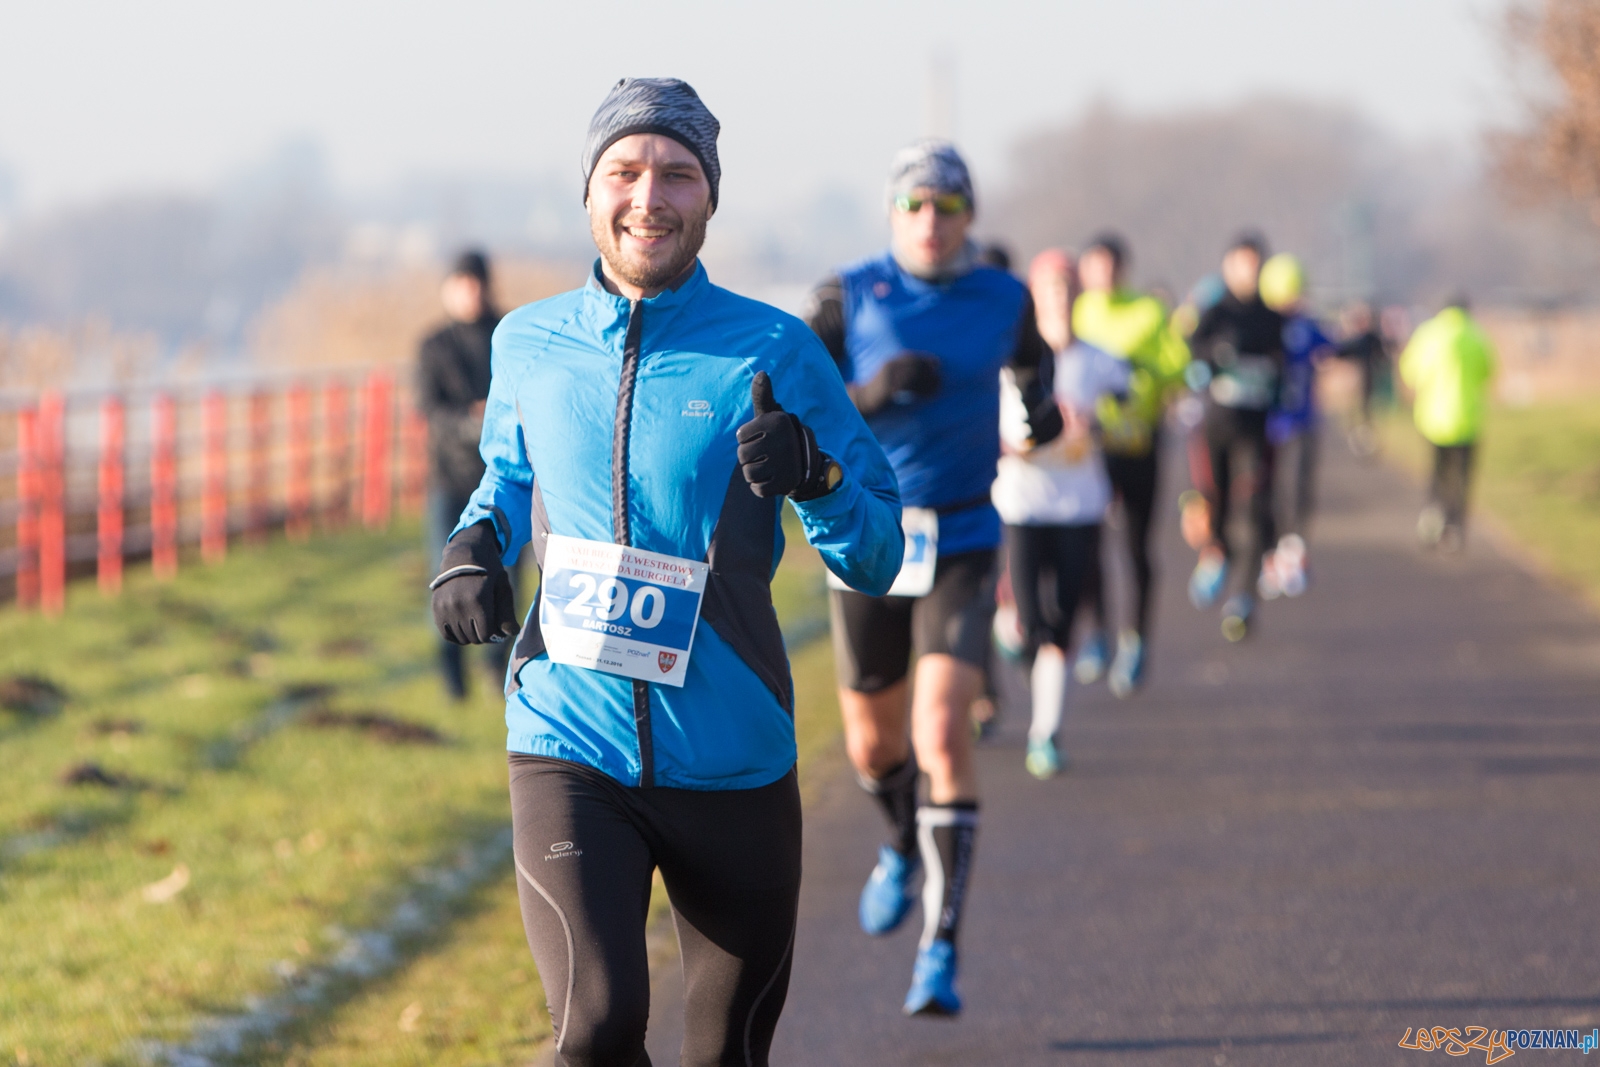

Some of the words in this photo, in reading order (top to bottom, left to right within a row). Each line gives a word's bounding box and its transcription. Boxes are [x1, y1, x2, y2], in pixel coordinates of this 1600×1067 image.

[582, 559, 631, 576] RYSZDA
[633, 567, 687, 587] BURGIELA
[614, 552, 695, 576] YLWESTROWY
[563, 573, 666, 629] 290
[582, 619, 633, 637] BARTOSZ
